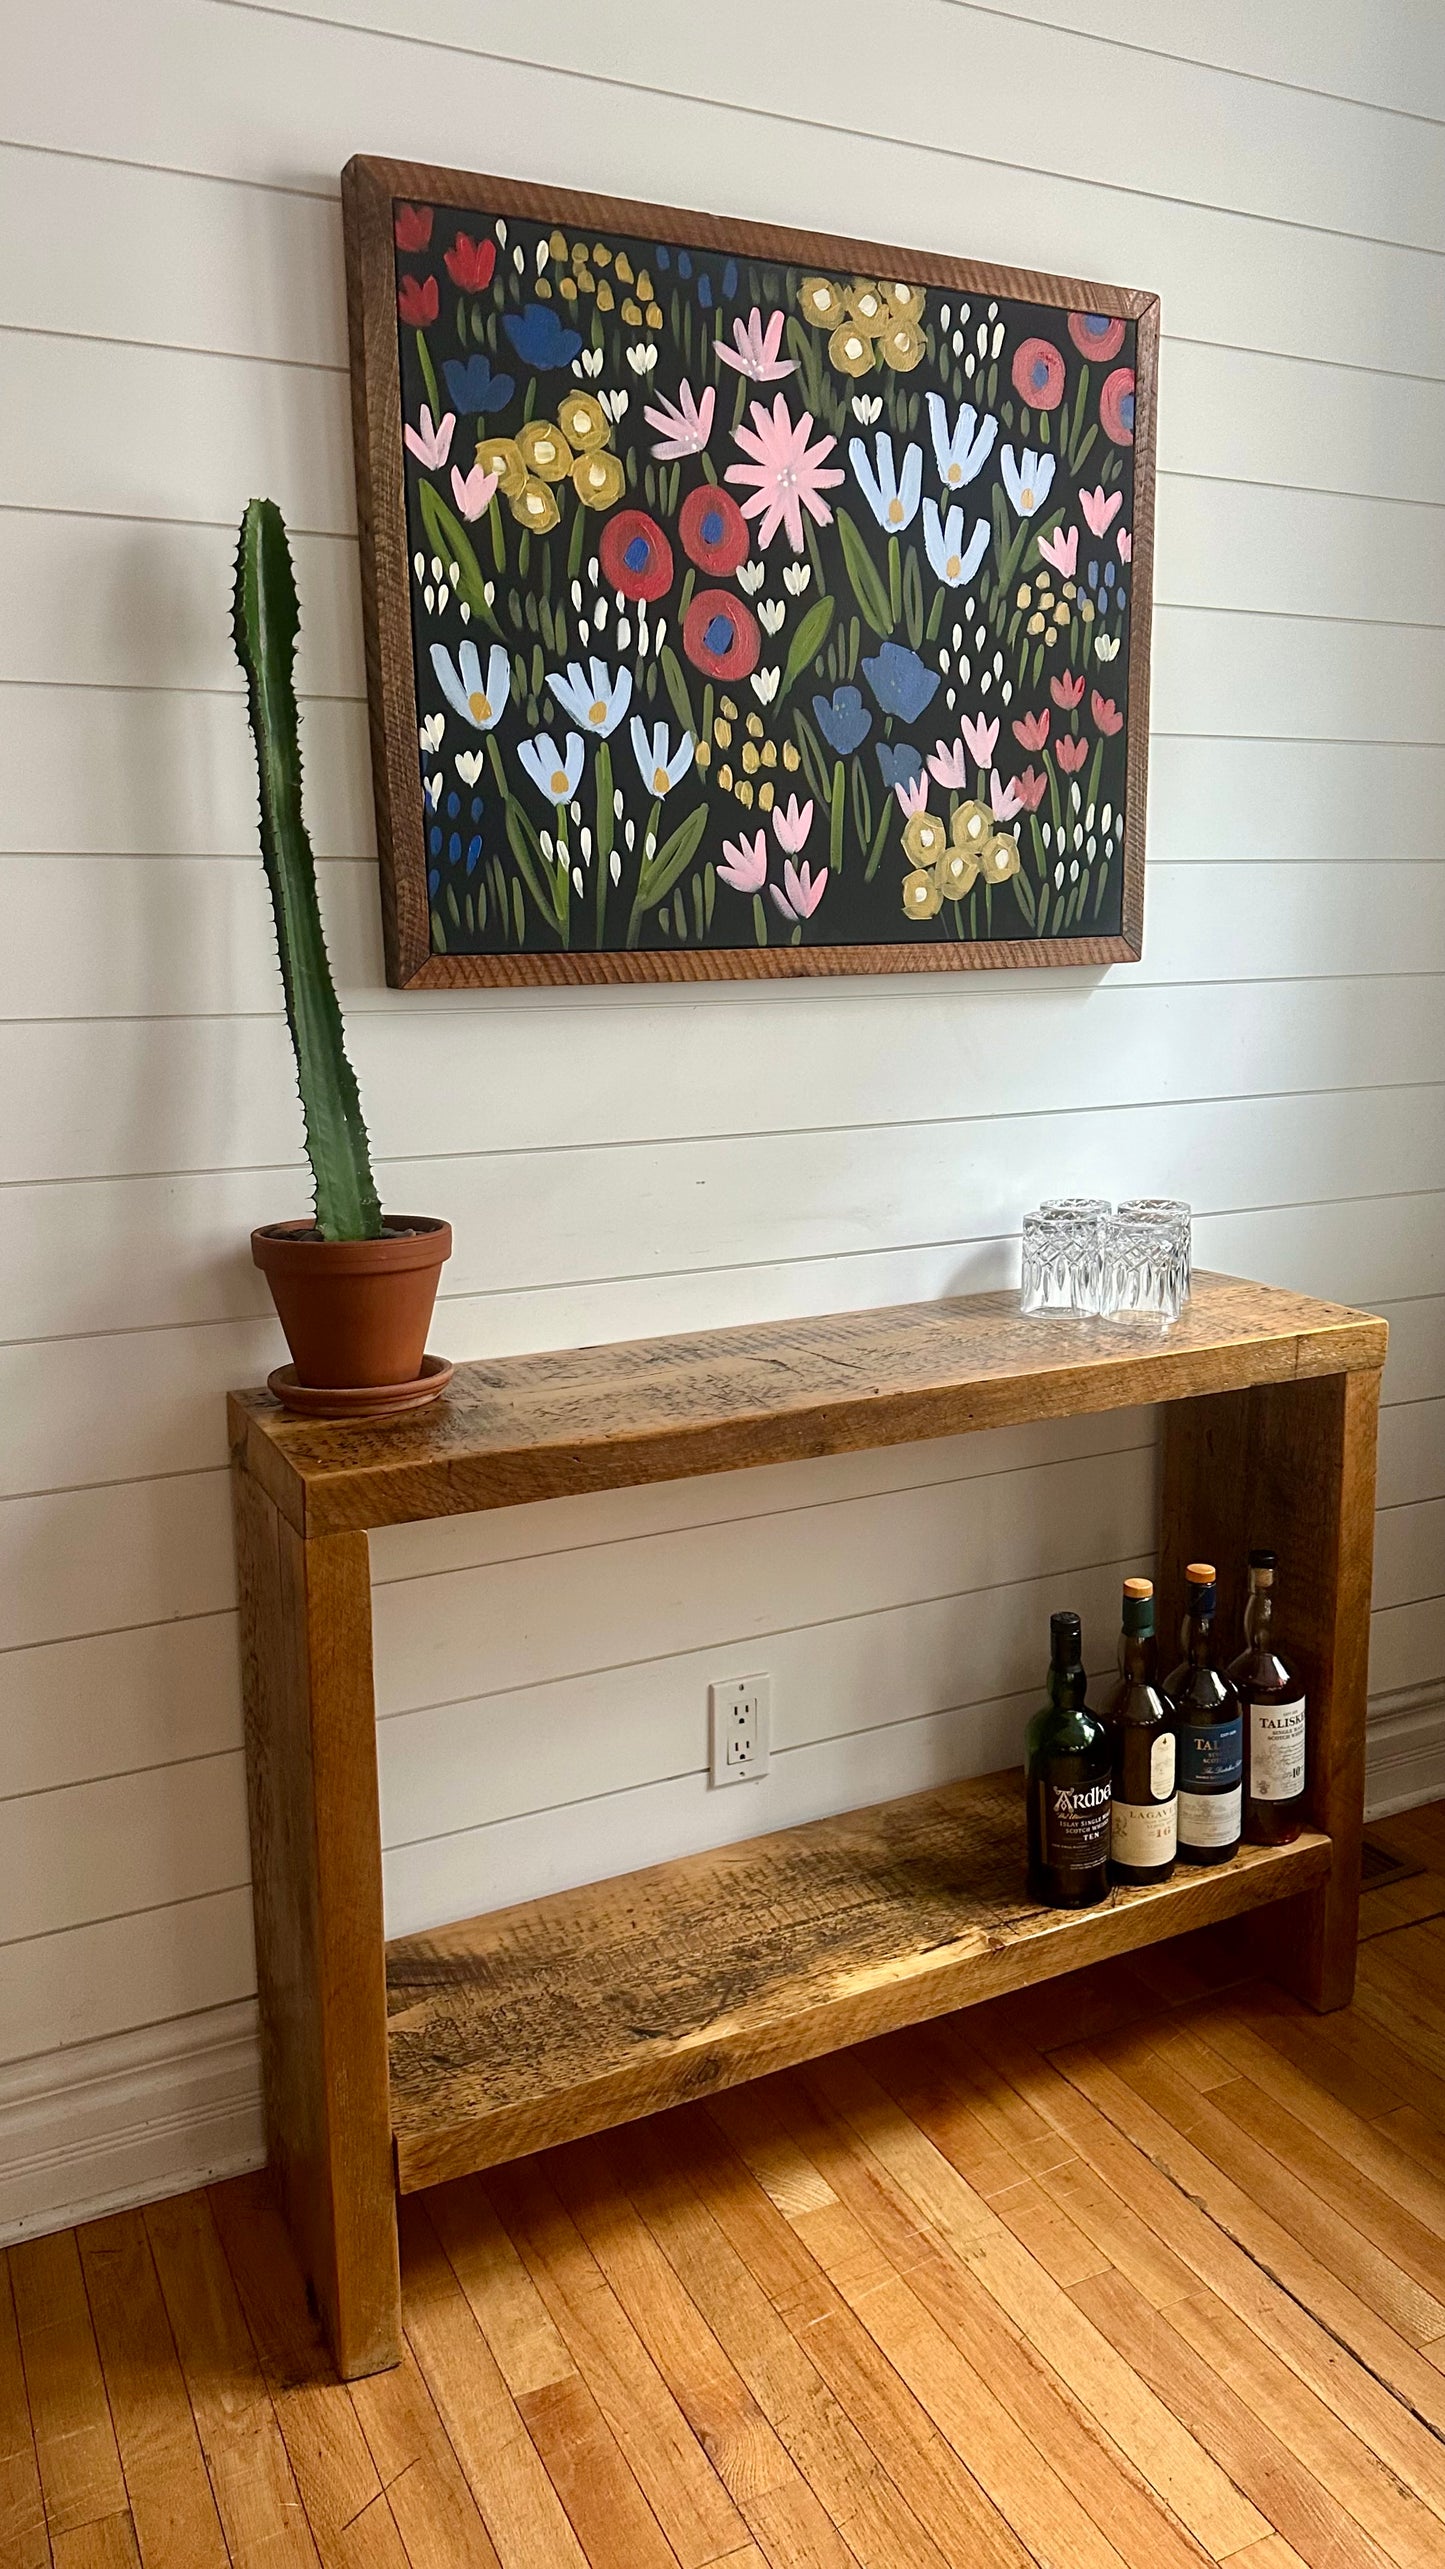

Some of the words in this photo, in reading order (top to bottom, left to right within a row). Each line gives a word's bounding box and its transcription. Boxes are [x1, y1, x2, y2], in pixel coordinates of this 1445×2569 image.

[1259, 1711, 1305, 1729] TALISKE
[1053, 1780, 1112, 1813] Ardbe
[1080, 1815, 1101, 1827] SINGLE
[1083, 1832, 1099, 1841] TEN
[1156, 1825, 1171, 1838] 16
